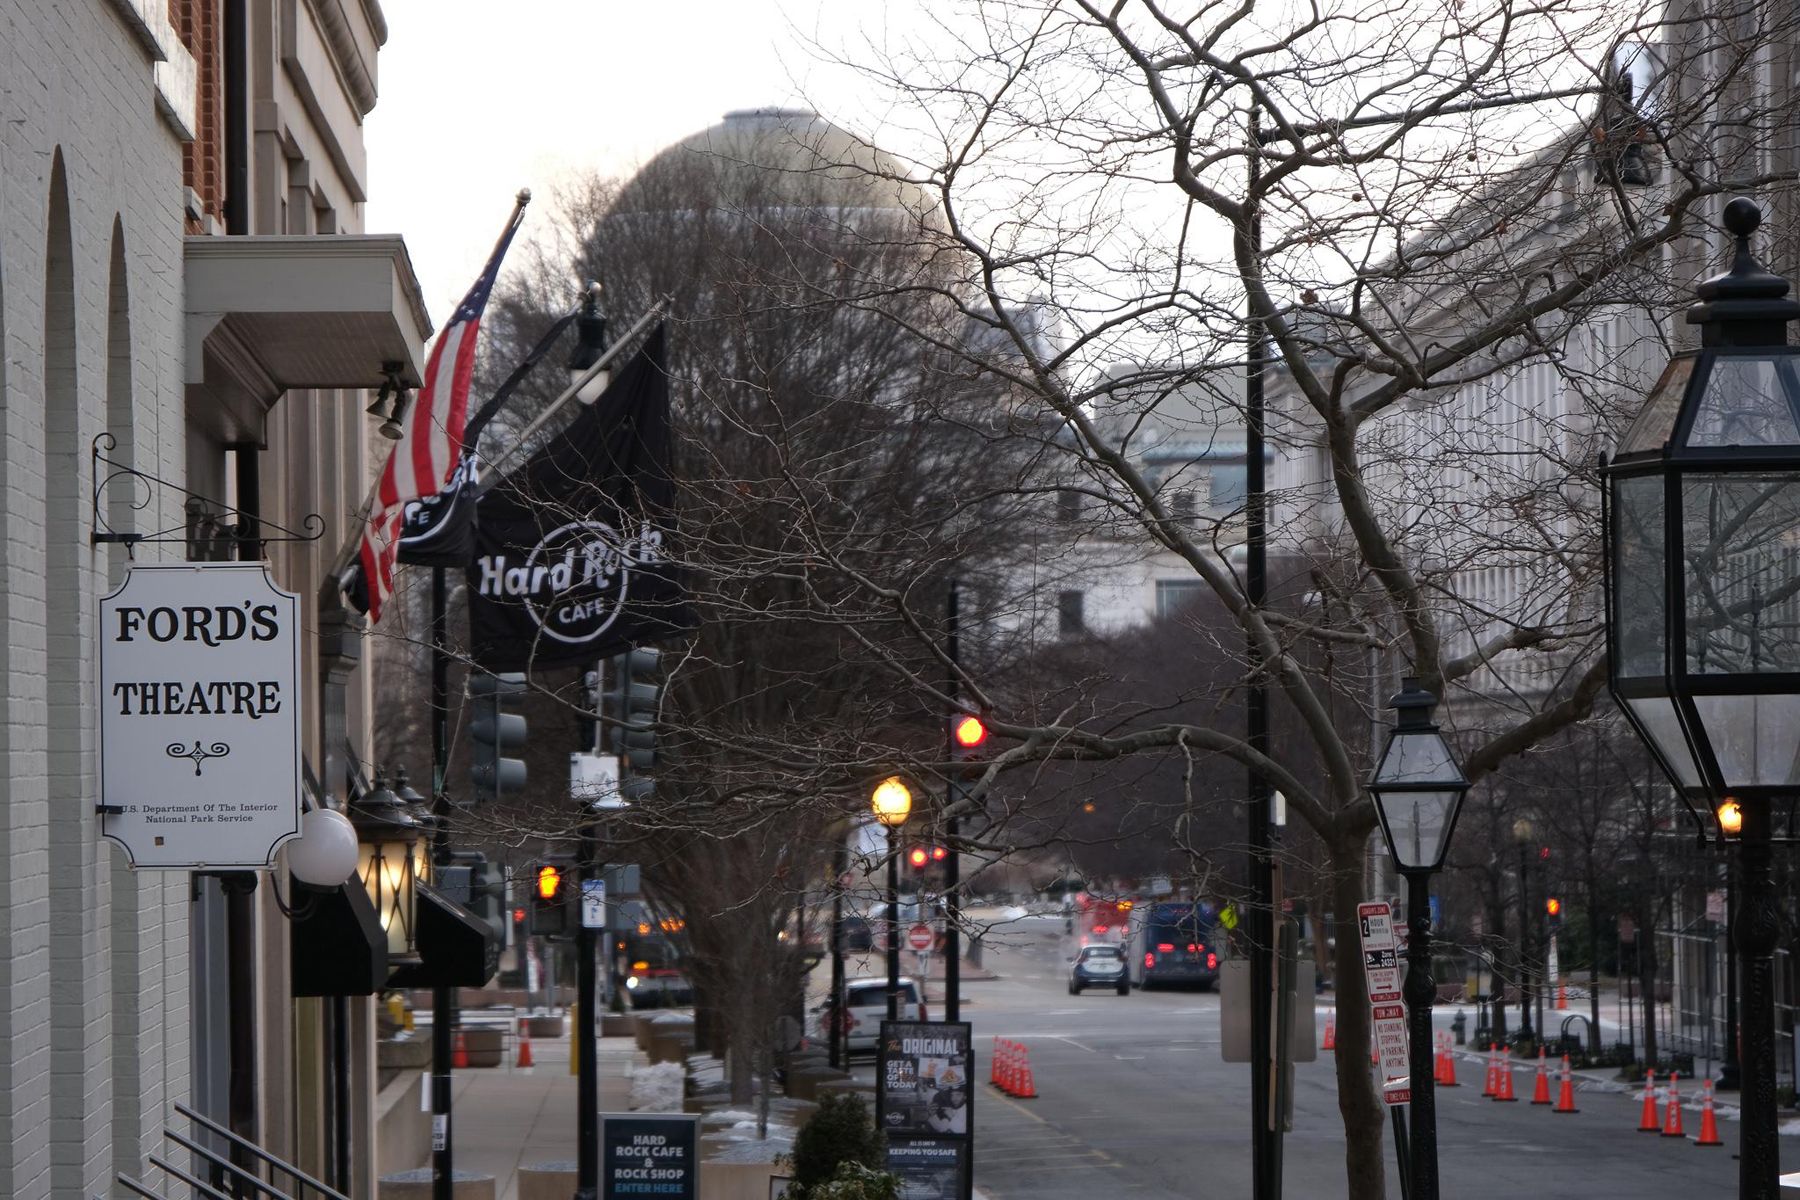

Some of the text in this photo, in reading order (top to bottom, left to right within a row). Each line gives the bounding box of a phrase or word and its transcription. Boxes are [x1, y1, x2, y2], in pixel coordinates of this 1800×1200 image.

[477, 547, 575, 597] Hard
[558, 597, 606, 625] CAFE
[115, 600, 279, 648] FORD'S
[113, 681, 281, 720] THEATRE
[142, 804, 200, 815] Department
[203, 803, 215, 813] Of
[218, 803, 236, 813] The
[240, 803, 278, 813] Interior
[145, 814, 253, 825] National Park Service
[1363, 920, 1369, 935] 2
[1370, 919, 1384, 927] HOUR
[1381, 1034, 1401, 1044] STOPPING
[902, 1038, 959, 1055] ORIGINAL
[1386, 1046, 1405, 1056] PARKING
[887, 1060, 913, 1068] GET A
[1386, 1057, 1405, 1067] ANYTIME
[887, 1067, 914, 1075] TASTE
[887, 1074, 898, 1082] OF
[887, 1081, 917, 1089] TODAY
[633, 1135, 666, 1145] HARD
[615, 1146, 684, 1157] ROCK CAFE
[888, 1148, 921, 1156] KEEPING
[922, 1148, 938, 1156] YOU
[644, 1157, 654, 1168] &
[614, 1168, 685, 1180] ROCK SHOP
[615, 1183, 684, 1193] ENTER HERE
